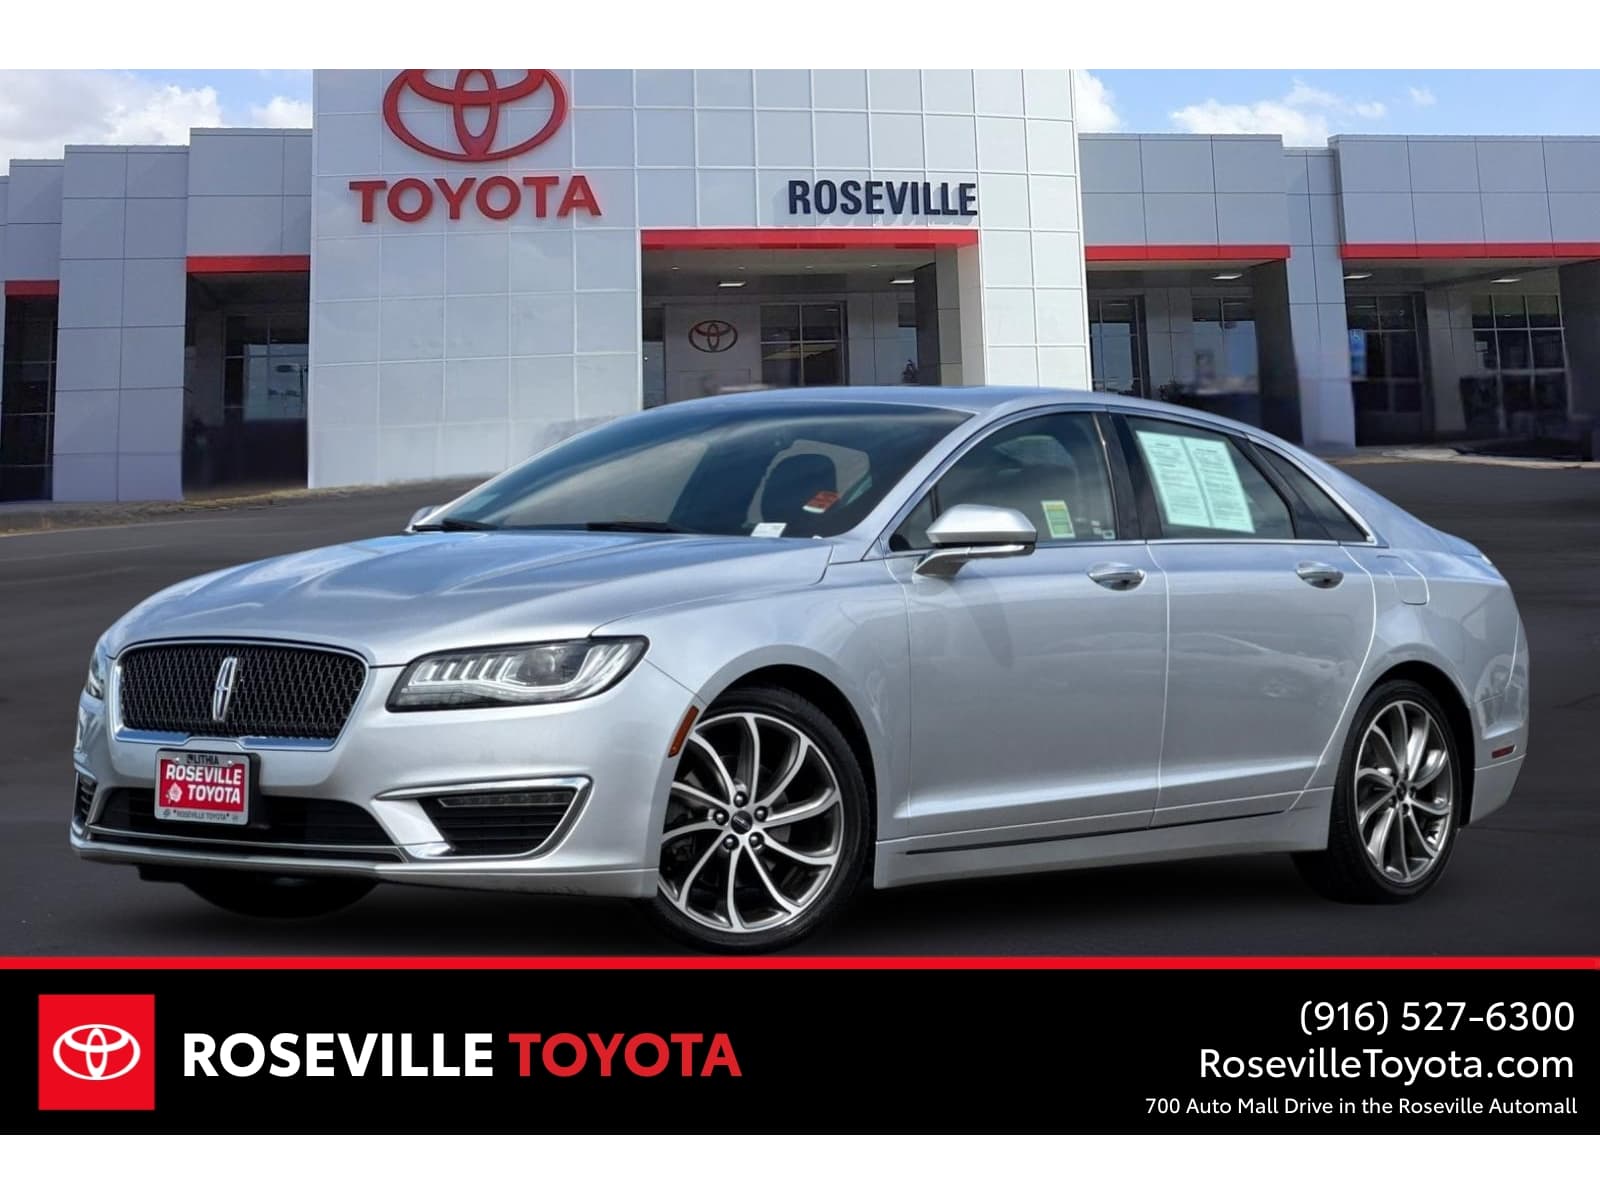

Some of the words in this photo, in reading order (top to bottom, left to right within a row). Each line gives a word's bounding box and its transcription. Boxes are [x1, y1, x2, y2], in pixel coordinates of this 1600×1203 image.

[349, 175, 601, 222] TOYOTA
[788, 180, 978, 216] ROSEVILLE
[194, 754, 220, 765] LITHIA
[166, 765, 242, 784] ROSEVILLE
[188, 785, 240, 804] TOYOTA
